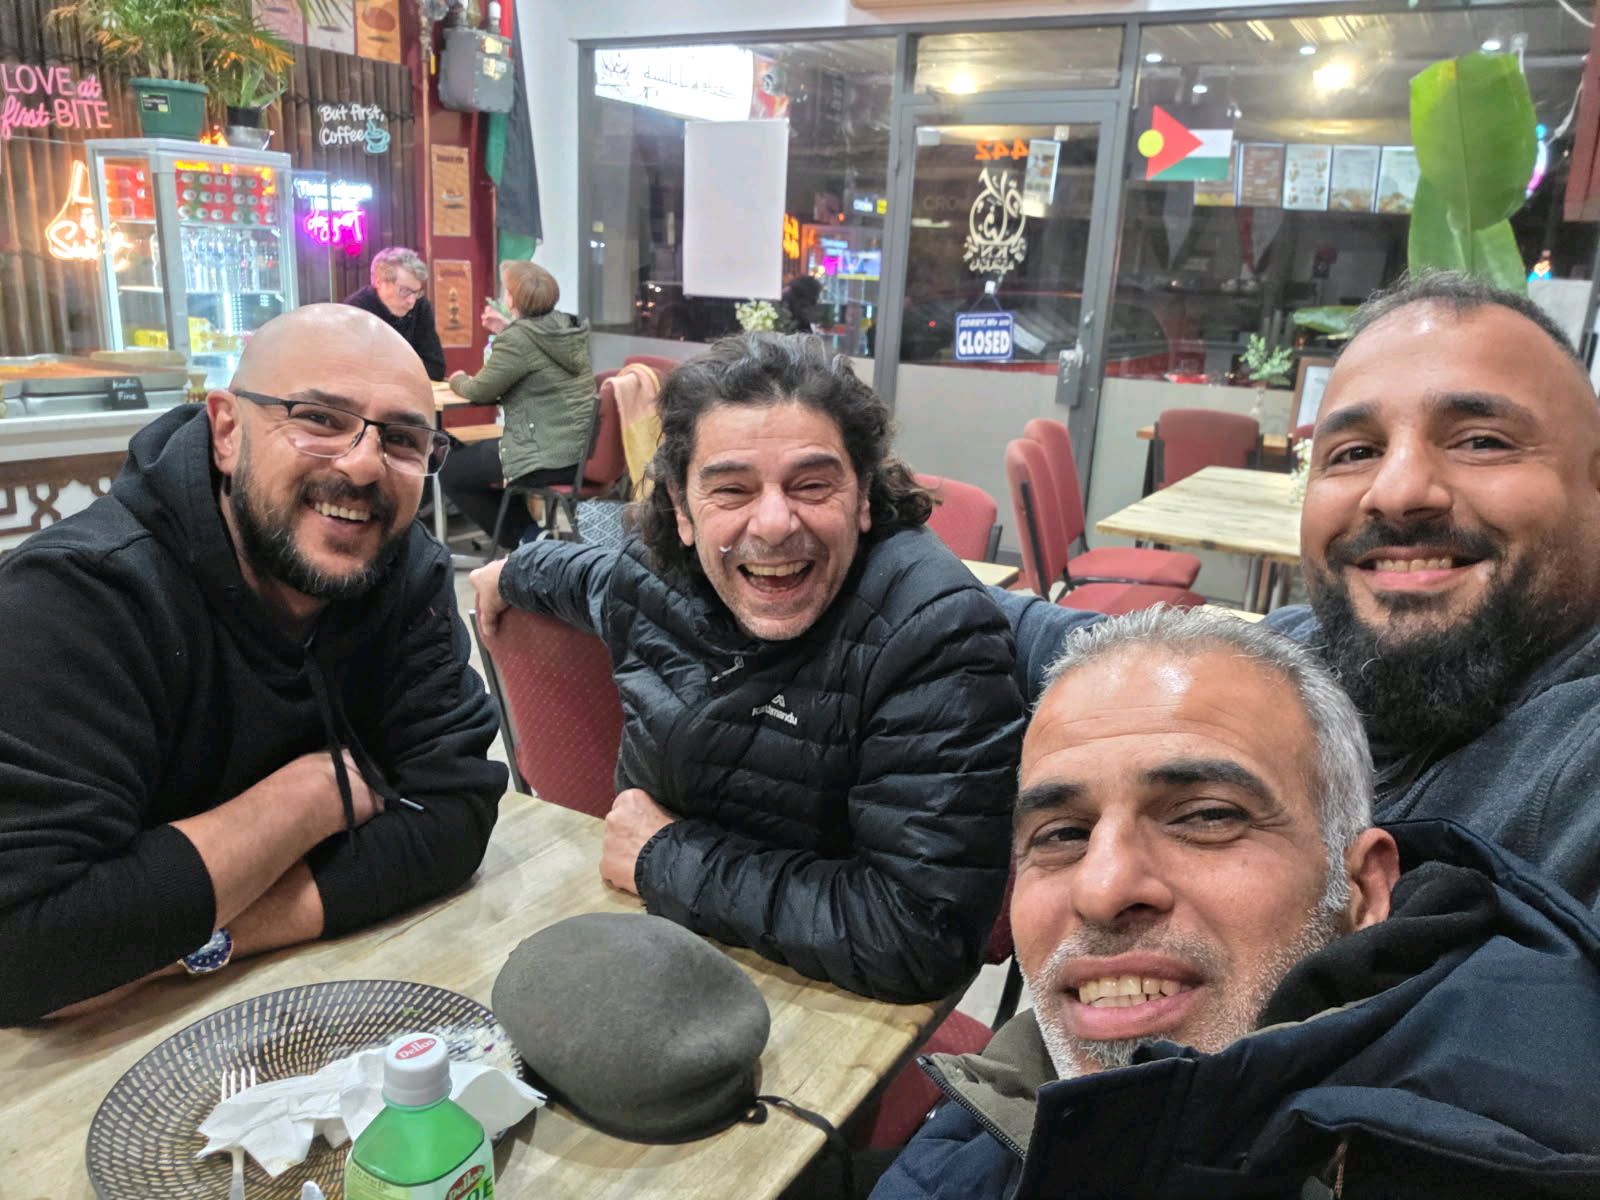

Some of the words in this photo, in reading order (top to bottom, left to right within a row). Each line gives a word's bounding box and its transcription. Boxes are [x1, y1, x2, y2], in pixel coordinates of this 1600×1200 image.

[1, 64, 74, 95] LOVE
[77, 74, 101, 98] at
[1, 95, 50, 139] first
[54, 98, 112, 128] BITE
[320, 105, 347, 122] But
[321, 125, 365, 145] Coffee
[959, 330, 1010, 355] CLOSED
